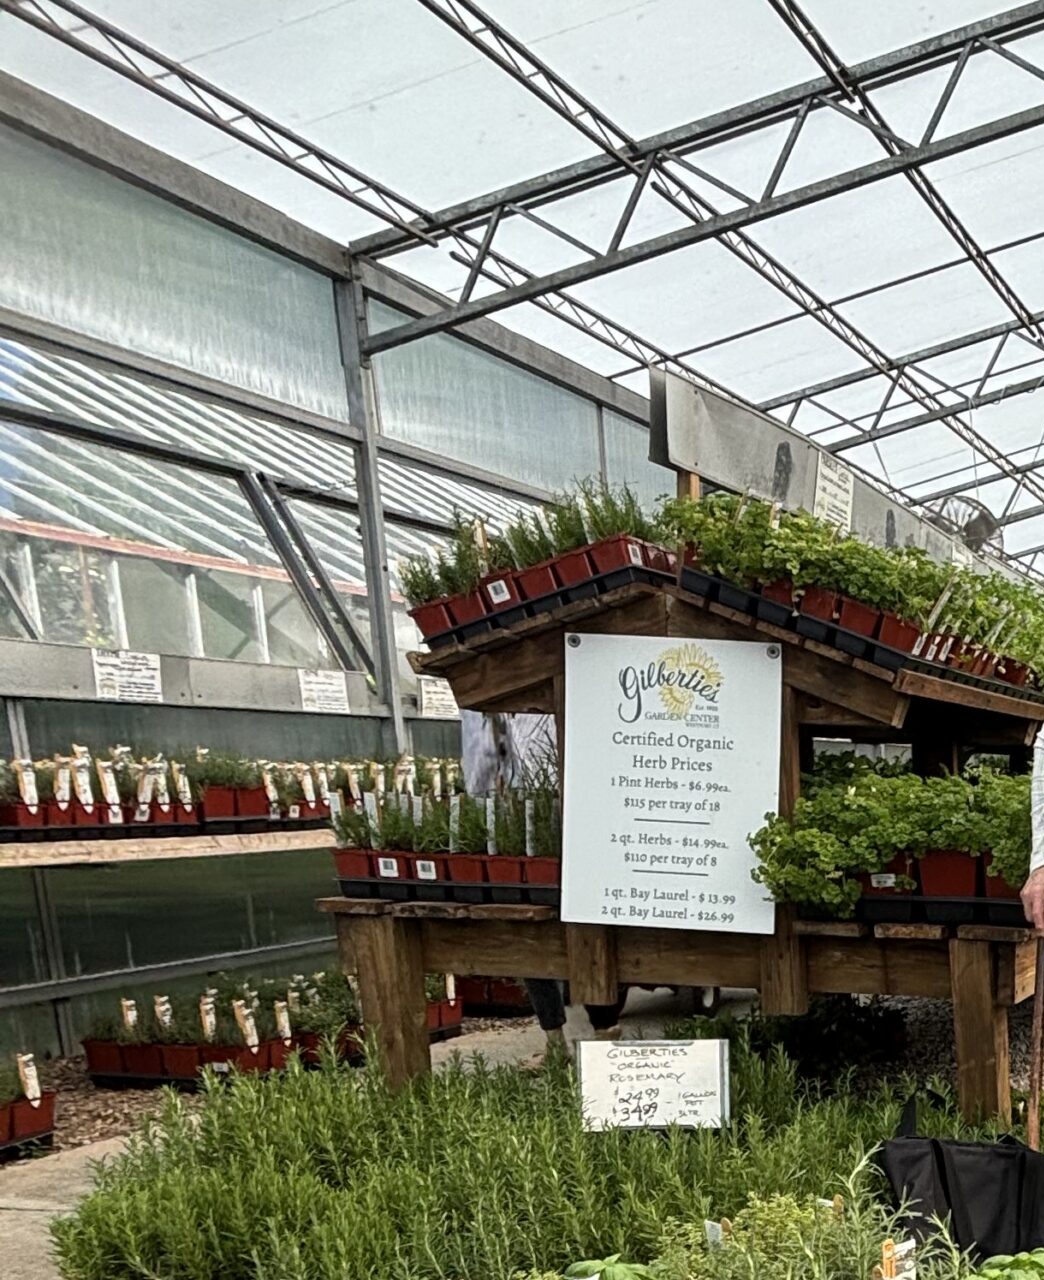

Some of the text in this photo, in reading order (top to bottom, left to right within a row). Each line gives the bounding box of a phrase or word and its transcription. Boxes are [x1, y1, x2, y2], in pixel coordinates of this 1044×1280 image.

[618, 661, 720, 723] Gilbertie's
[645, 711, 720, 723] GARDEN CENTER
[612, 731, 734, 752] Certified Organic
[632, 754, 713, 772] Herb Prices
[611, 777, 615, 786] 1
[619, 776, 642, 788] Pint
[644, 777, 678, 790] Herbs
[624, 797, 720, 813] $115 per tray of 18
[610, 833, 617, 843] 2
[619, 834, 635, 846] qt.
[638, 833, 672, 846] Herbs
[624, 852, 717, 868] $110 per tray of 8
[604, 888, 609, 896] 1
[611, 888, 627, 900] qt.
[630, 887, 651, 902] Bay
[653, 888, 689, 901] Laurel
[708, 894, 736, 905] 13.99
[601, 906, 608, 915] 2
[610, 906, 626, 918] qt.
[629, 905, 649, 920] Bay
[652, 907, 688, 919] Laurel
[697, 911, 735, 923] $26.99
[607, 1048, 688, 1059] GILBERTIES
[609, 1072, 686, 1084] ROSEMARY
